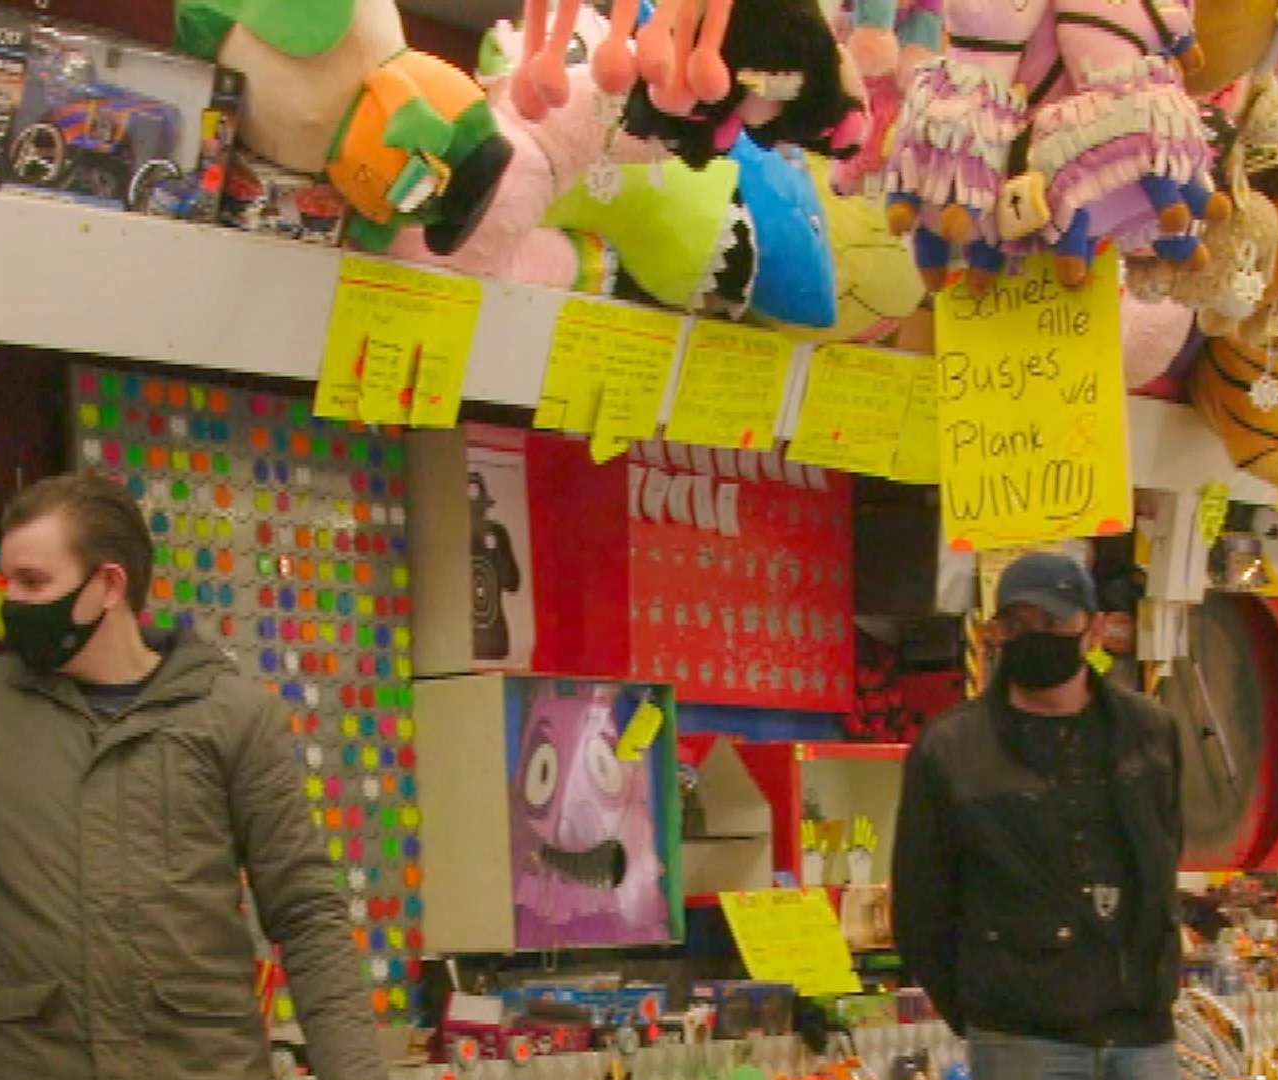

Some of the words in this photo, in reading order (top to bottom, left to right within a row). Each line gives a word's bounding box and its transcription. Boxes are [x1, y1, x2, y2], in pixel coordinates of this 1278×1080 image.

[1038, 304, 1090, 337] Alle
[940, 348, 1060, 401] Busjes
[944, 419, 1044, 465] Plank
